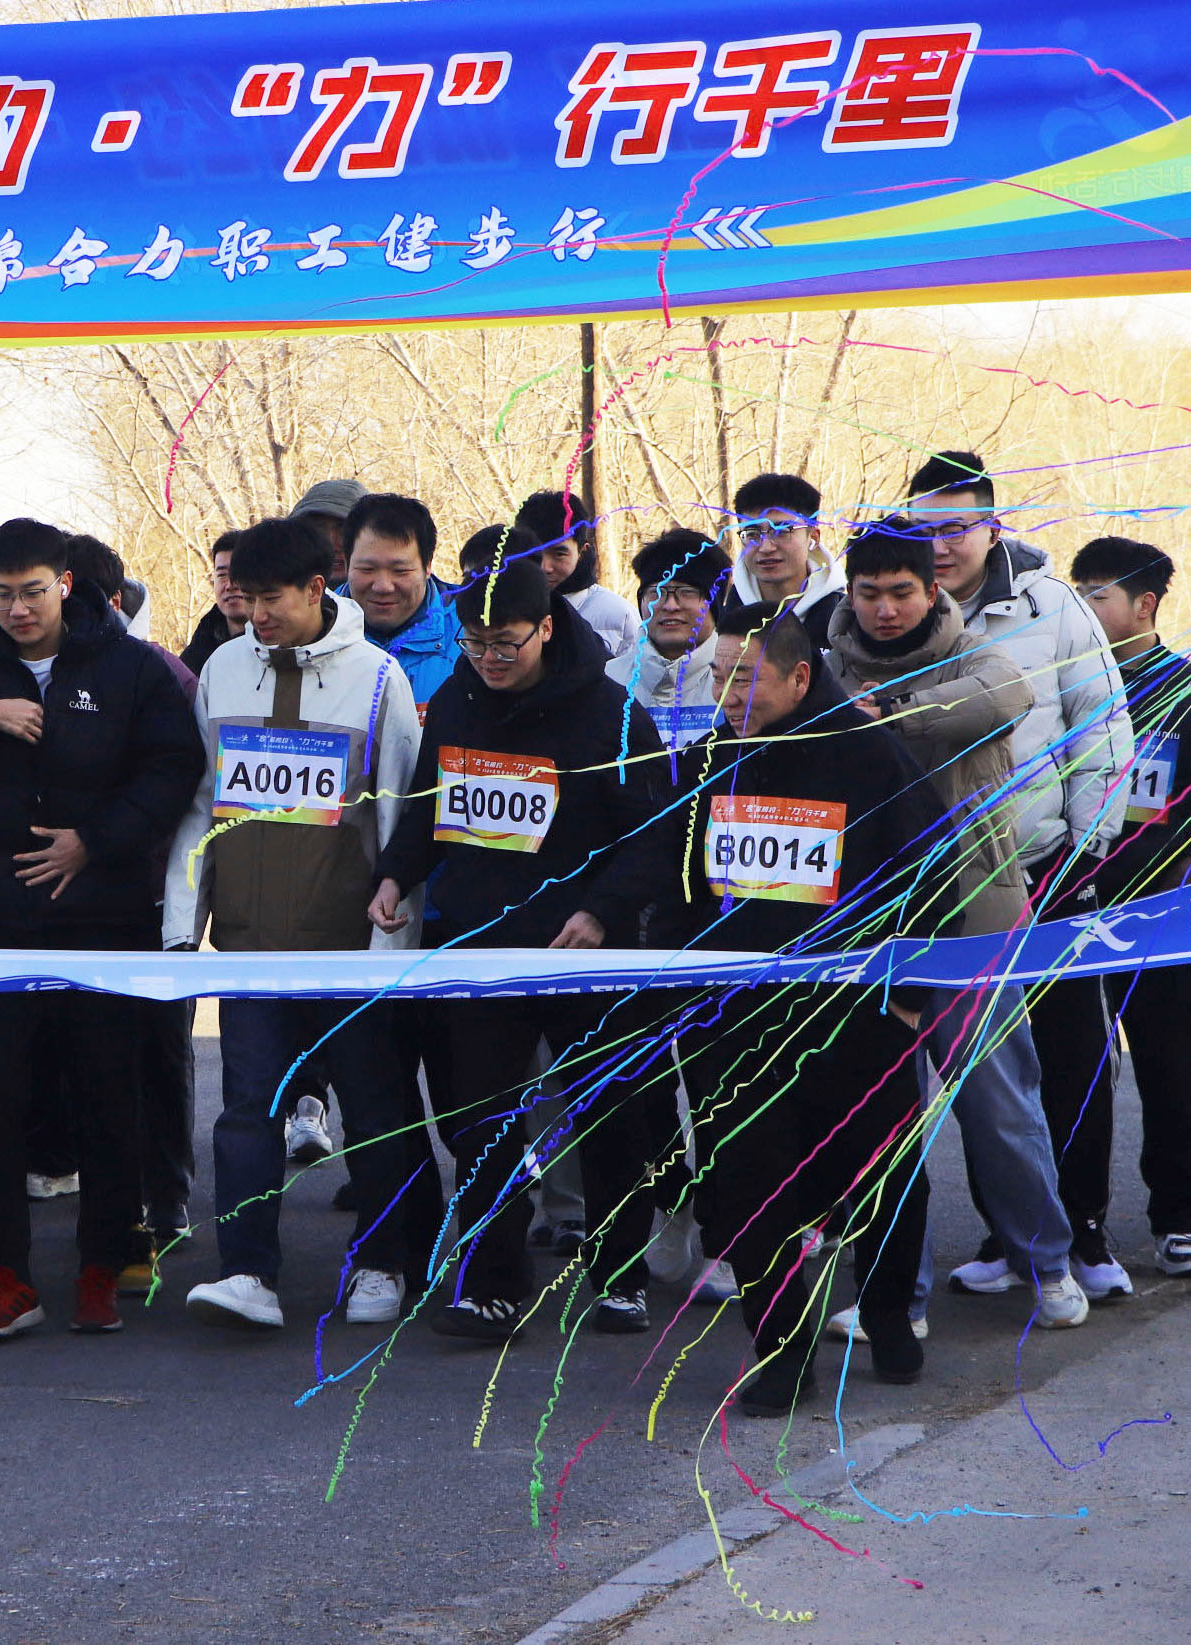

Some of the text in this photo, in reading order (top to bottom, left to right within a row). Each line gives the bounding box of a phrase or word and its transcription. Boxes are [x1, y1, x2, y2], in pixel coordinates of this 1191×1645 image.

[69, 701, 99, 711] CAMEL
[226, 762, 335, 798] A0016
[449, 785, 547, 825] B0008
[716, 834, 828, 873] B0014
